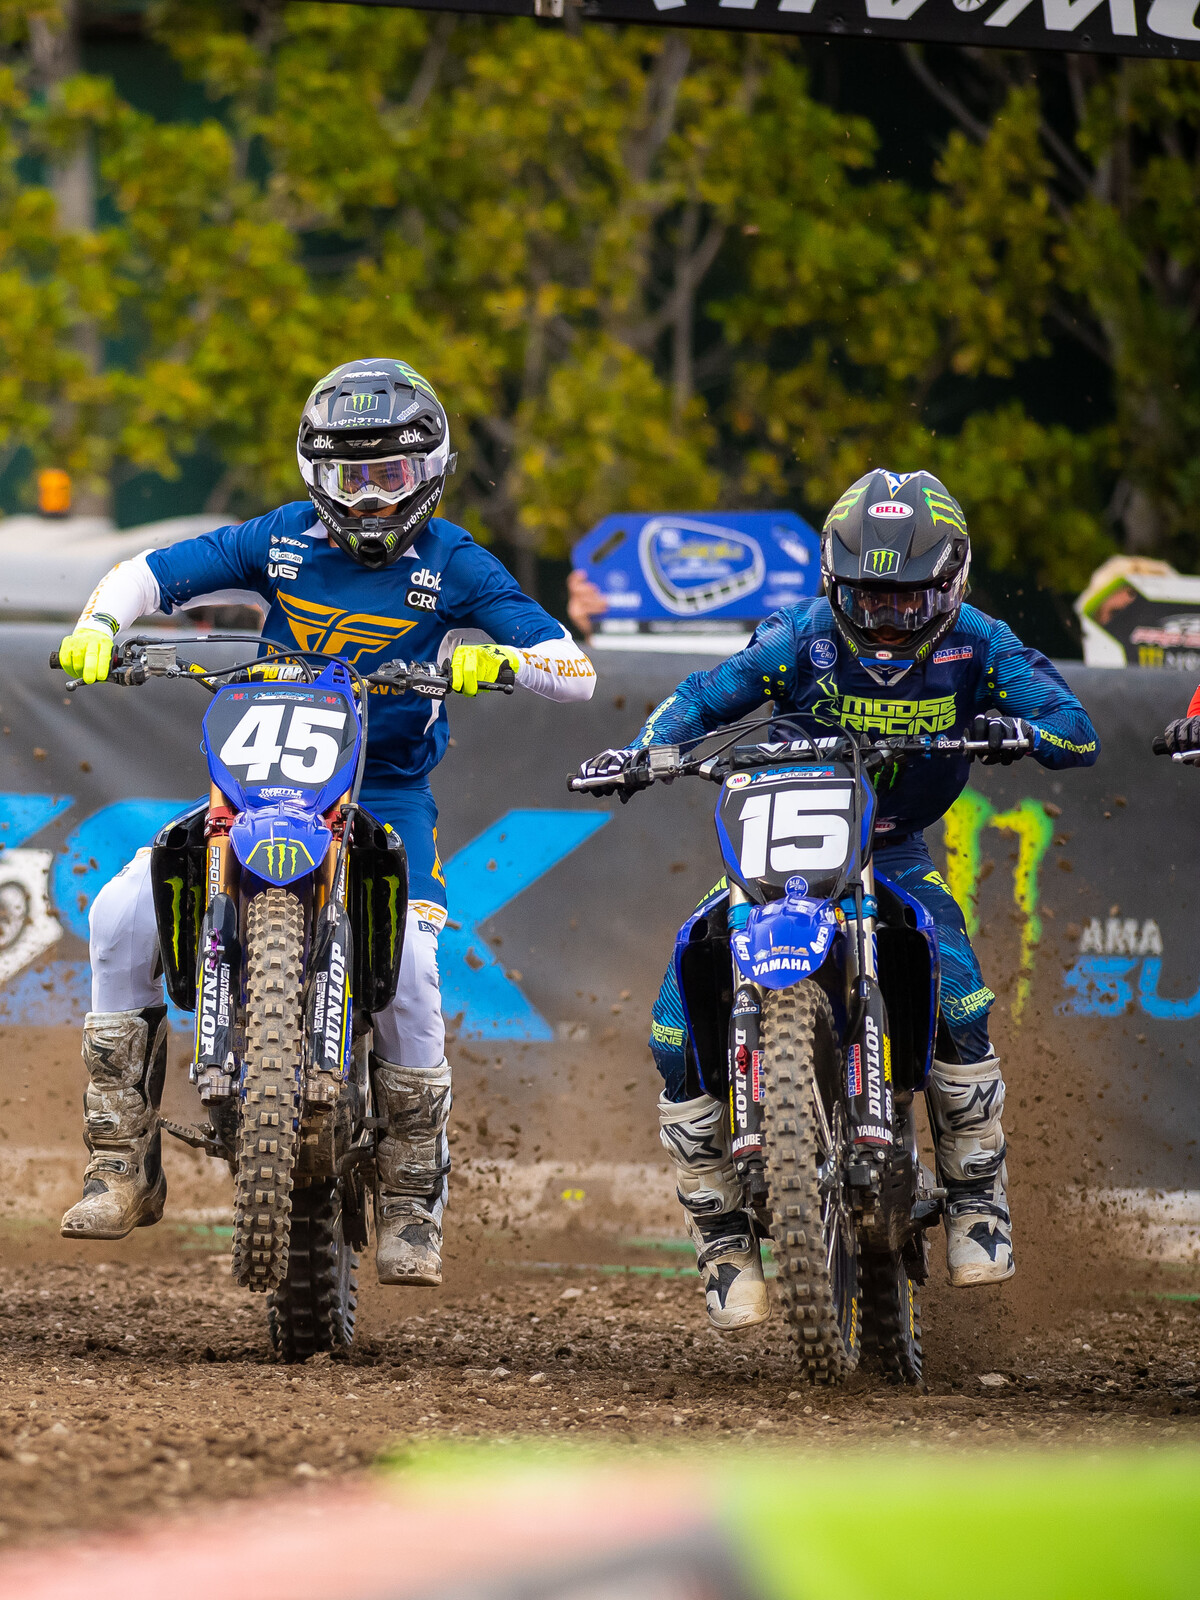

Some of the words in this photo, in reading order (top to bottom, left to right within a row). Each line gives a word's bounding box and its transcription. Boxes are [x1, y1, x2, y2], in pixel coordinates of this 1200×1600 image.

[875, 505, 906, 515] BELL
[934, 646, 972, 659] PARTS
[841, 711, 957, 736] RACING
[842, 692, 957, 718] MOOSE
[220, 704, 347, 784] 45
[738, 788, 852, 879] 15
[1080, 917, 1164, 956] AMA
[752, 958, 811, 977] YAMAHA
[219, 963, 231, 1016] HEATWAVE
[313, 982, 328, 1034] HEATWAVE
[324, 942, 347, 1064] DUNLOP
[733, 1005, 757, 1015] enzo
[865, 1015, 882, 1120] DUNLOP
